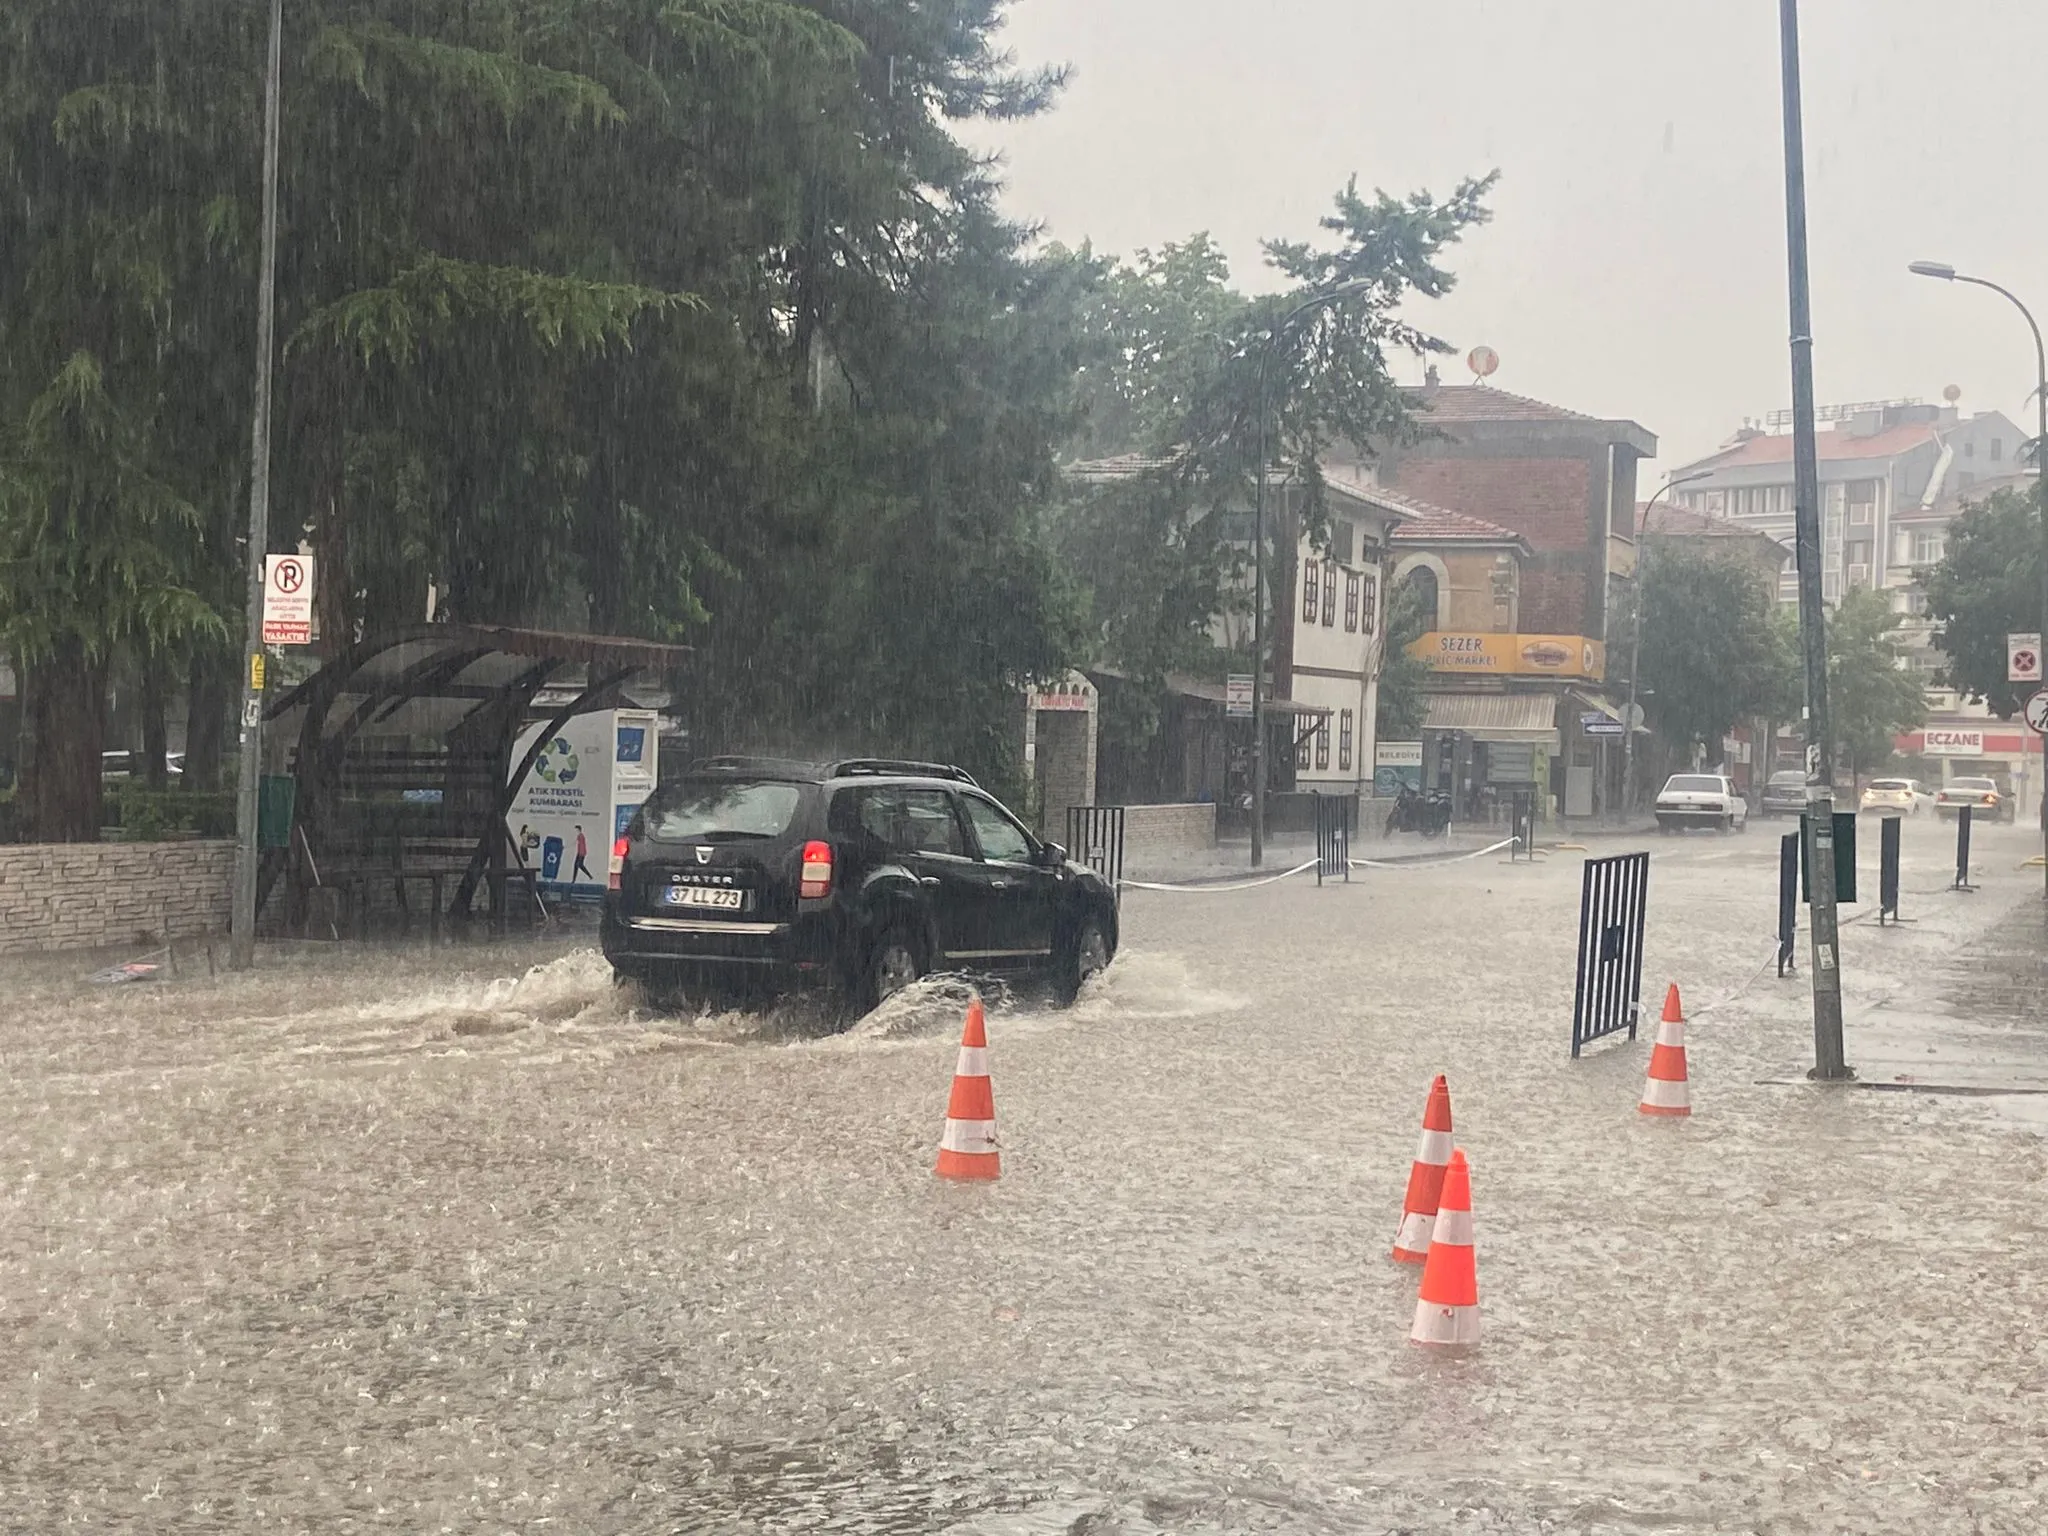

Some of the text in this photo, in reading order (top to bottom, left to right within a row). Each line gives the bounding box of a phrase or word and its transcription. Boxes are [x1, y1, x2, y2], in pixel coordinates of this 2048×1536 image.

[1440, 637, 1482, 652] SEZER
[1926, 732, 1980, 746] ECZANE
[529, 798, 583, 808] KUMBARASI
[671, 887, 739, 906] 37 LL 273
